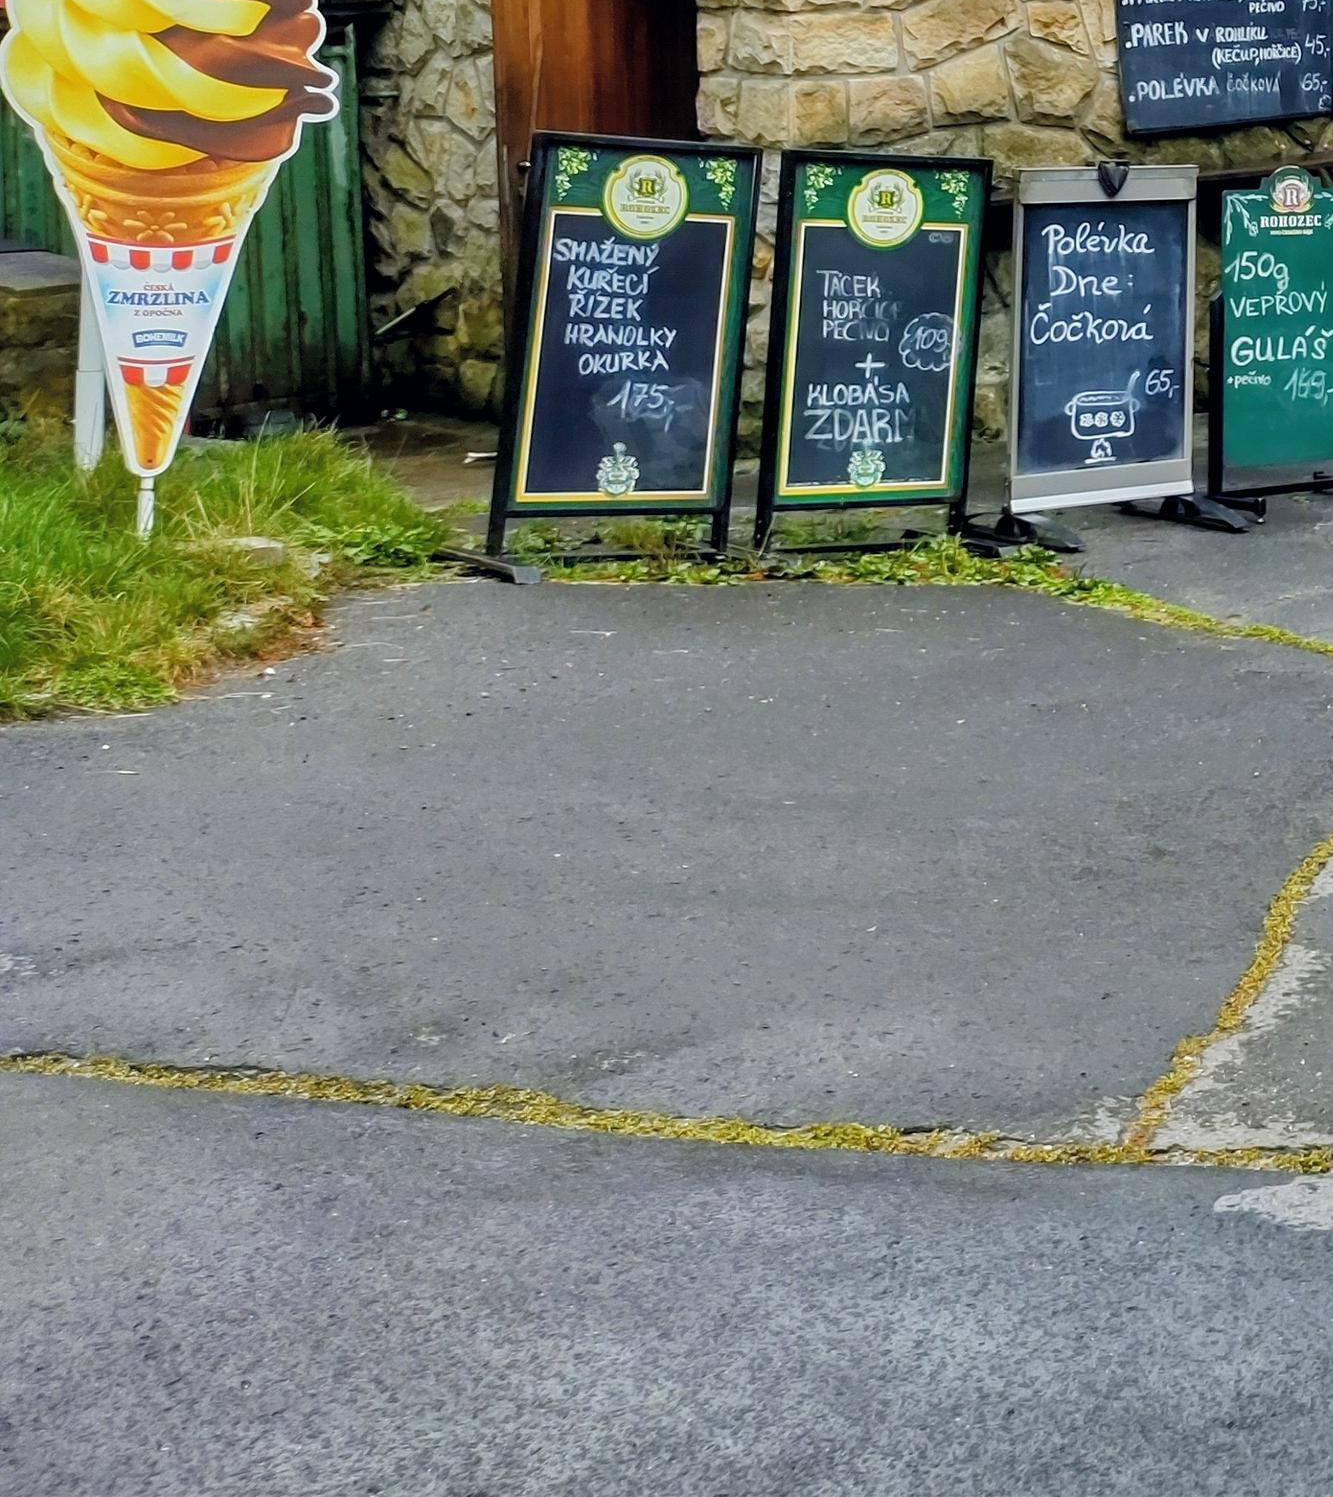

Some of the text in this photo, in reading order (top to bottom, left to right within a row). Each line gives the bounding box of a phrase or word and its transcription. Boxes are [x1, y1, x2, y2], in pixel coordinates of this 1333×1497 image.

[1137, 72, 1220, 101] POLÉVKA
[1260, 215, 1322, 228] ROHOZEC
[553, 236, 660, 267] SMAŽENÝ
[1042, 222, 1155, 255] Polévka
[144, 281, 174, 291] ČESKÁ
[567, 264, 660, 296] KUŘECÍ
[1224, 251, 1290, 294] 150g
[107, 291, 211, 305] ZMRZLINA
[569, 290, 645, 322] ŘÍZEK
[1230, 280, 1327, 318] VEPŘOVÝ
[564, 323, 677, 348] HRANOLKY
[1030, 303, 1153, 345] Čočková
[578, 350, 669, 375] OKURKA
[807, 376, 910, 407] KLOBÁSA
